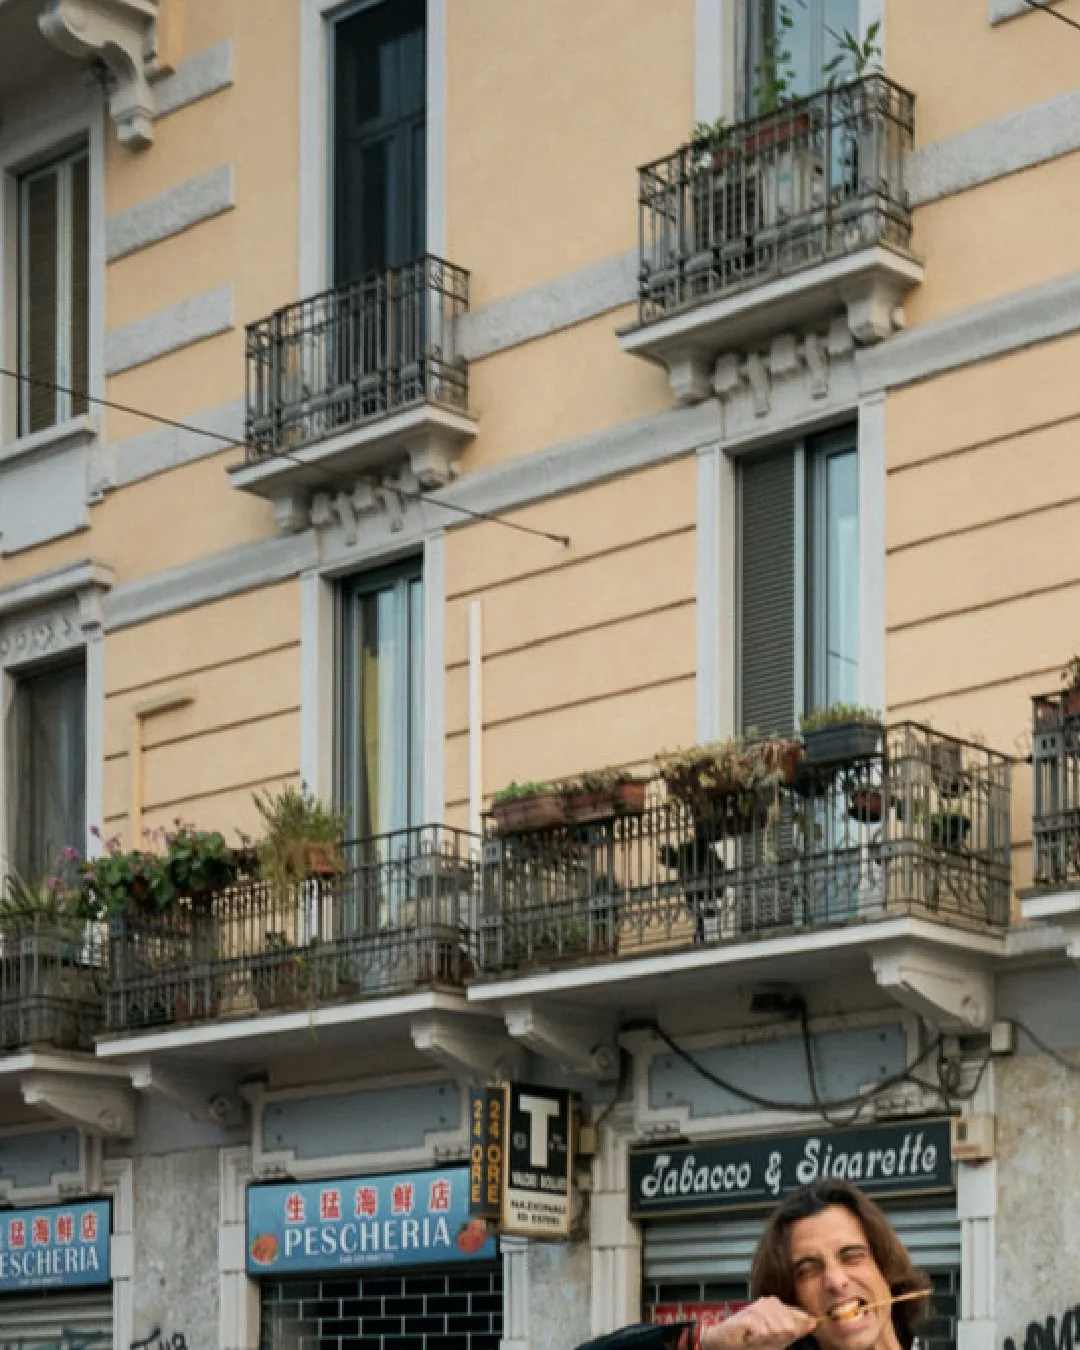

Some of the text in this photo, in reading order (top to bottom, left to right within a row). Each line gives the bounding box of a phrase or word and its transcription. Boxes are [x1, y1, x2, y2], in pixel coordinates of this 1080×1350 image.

[519, 1095, 560, 1167] T
[640, 1155, 752, 1198] Tabacco
[764, 1151, 782, 1196] &
[284, 1216, 451, 1257] PESCHERIA
